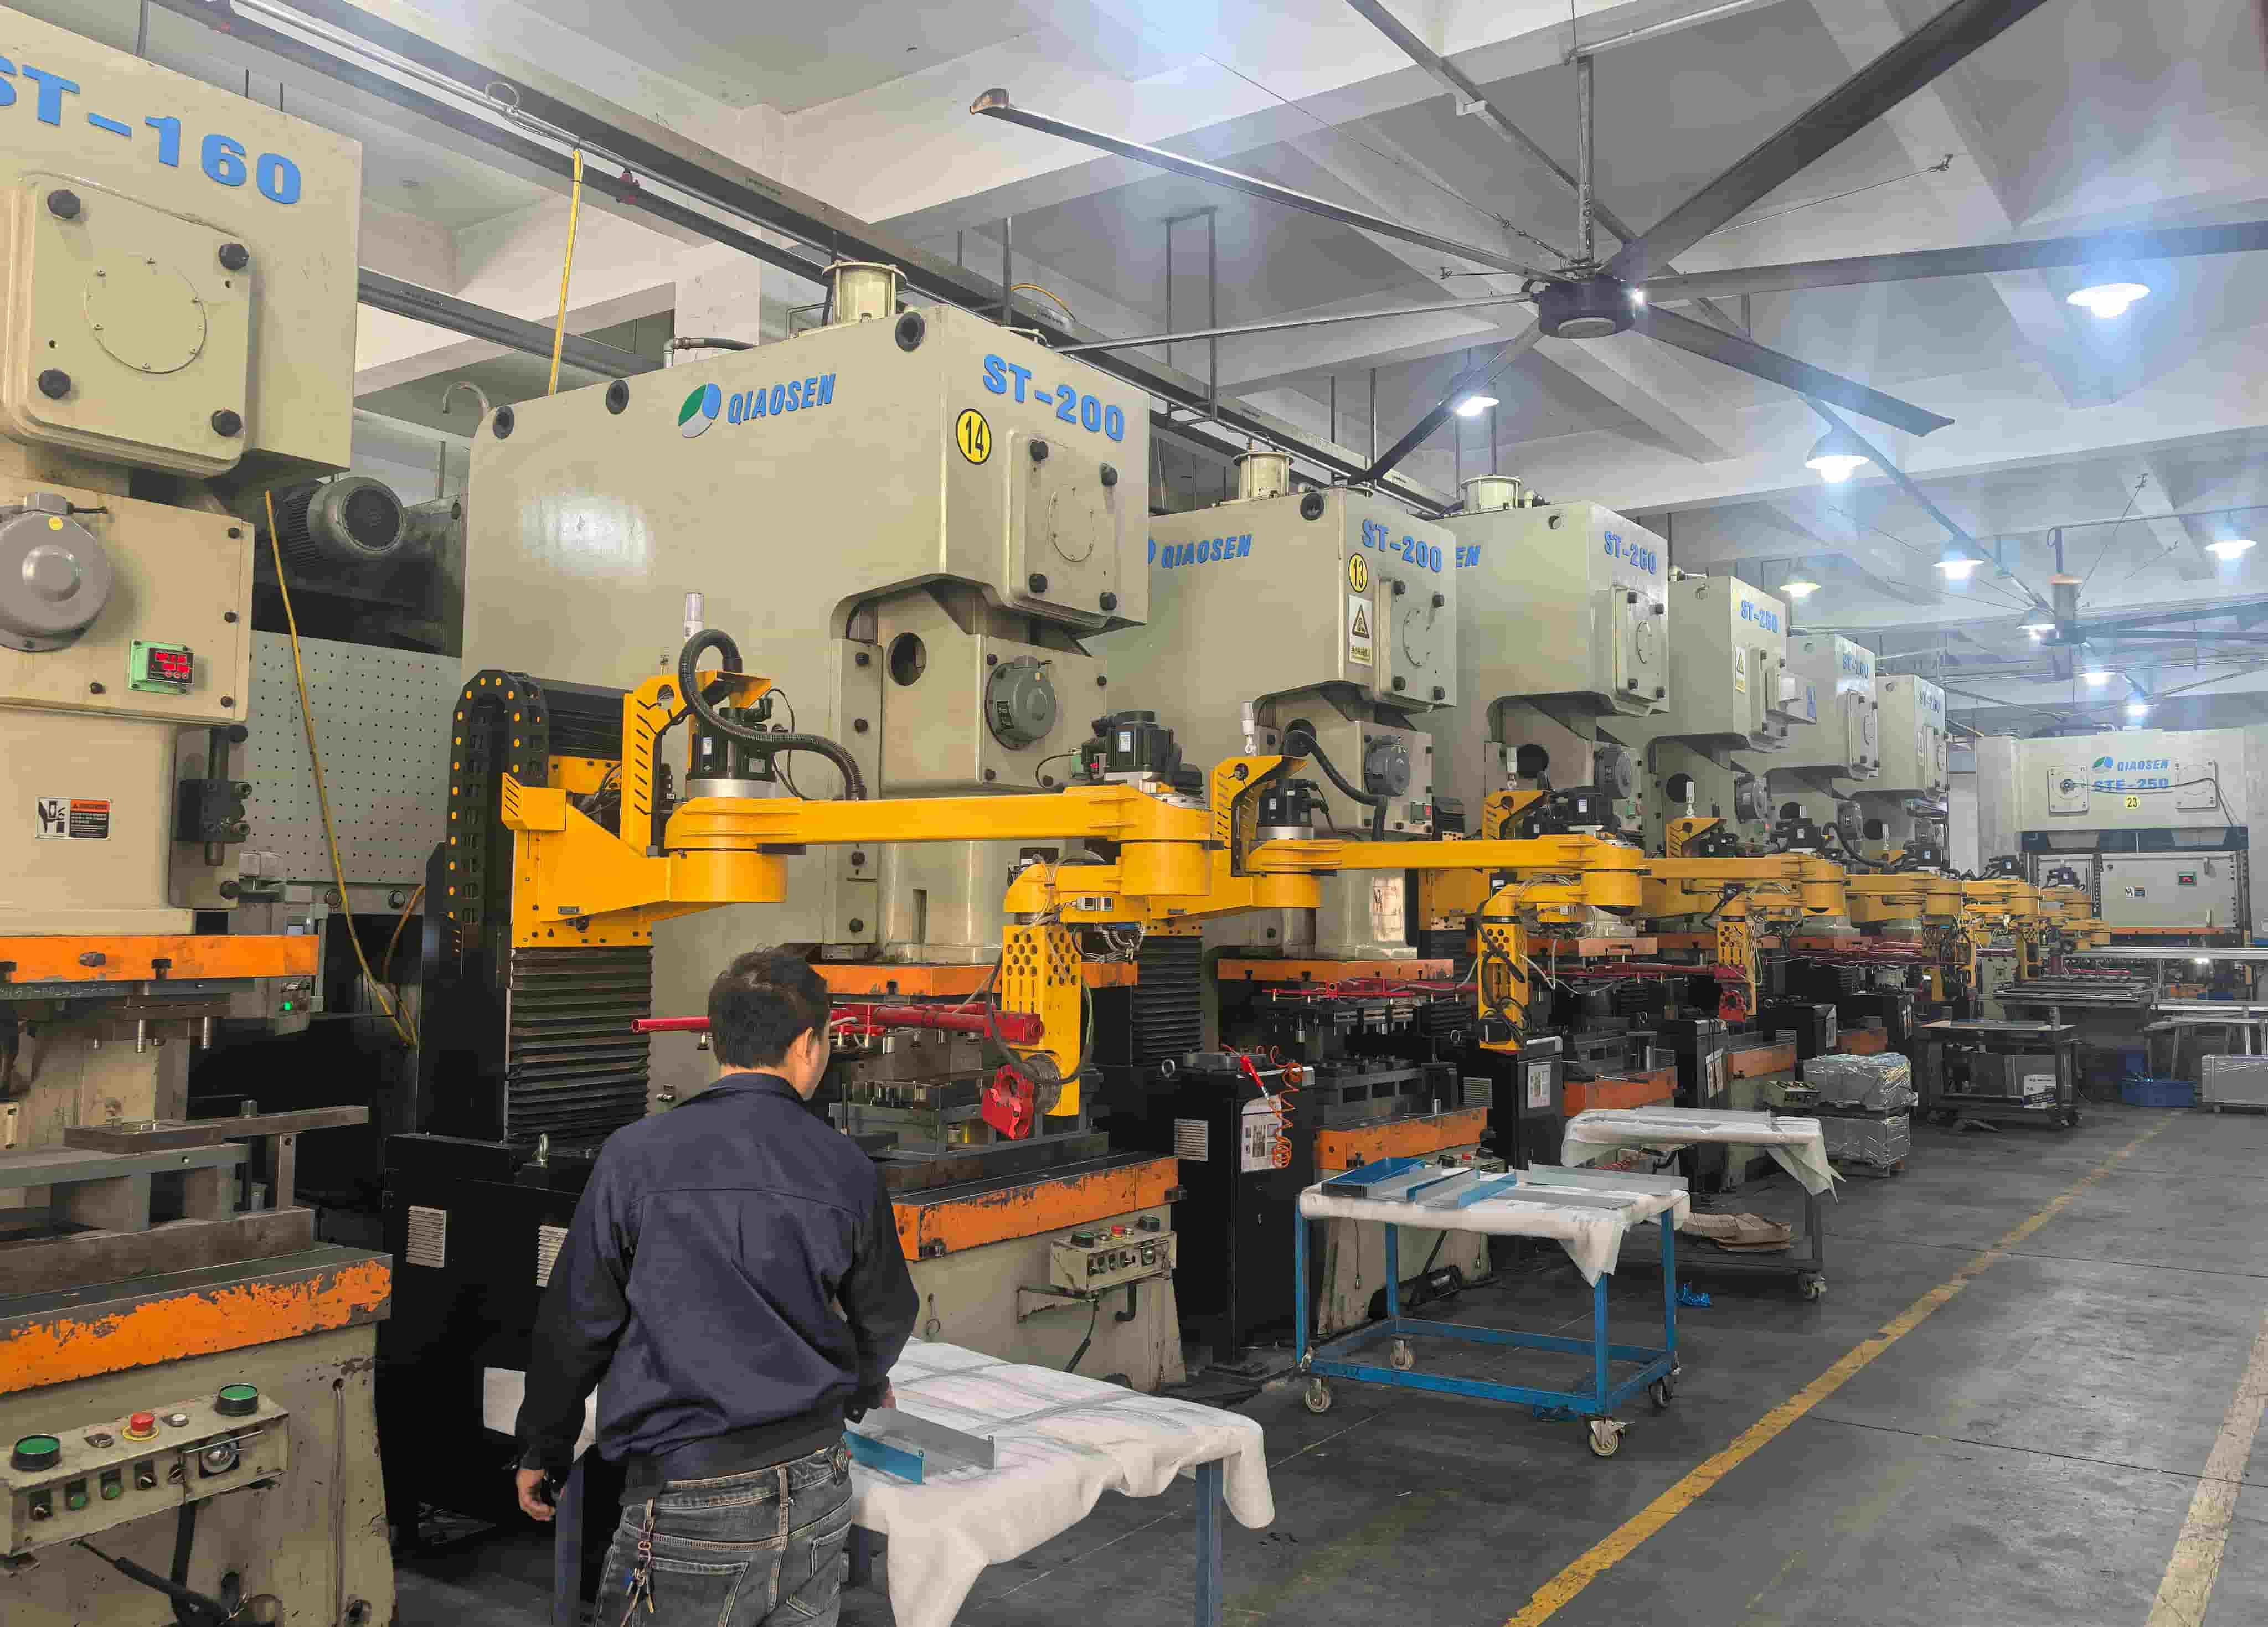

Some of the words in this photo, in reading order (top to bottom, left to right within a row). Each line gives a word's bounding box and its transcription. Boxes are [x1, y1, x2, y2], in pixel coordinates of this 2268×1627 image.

[727, 371, 837, 426] QIAOSEN
[983, 354, 1125, 442] ST-200
[965, 415, 984, 459] 14
[1161, 534, 1253, 569] QIAOSEN
[1362, 518, 1442, 573] ST-200
[1604, 530, 1657, 575] ST-260
[1353, 557, 1364, 588] 13
[2126, 797, 2138, 808] 23
